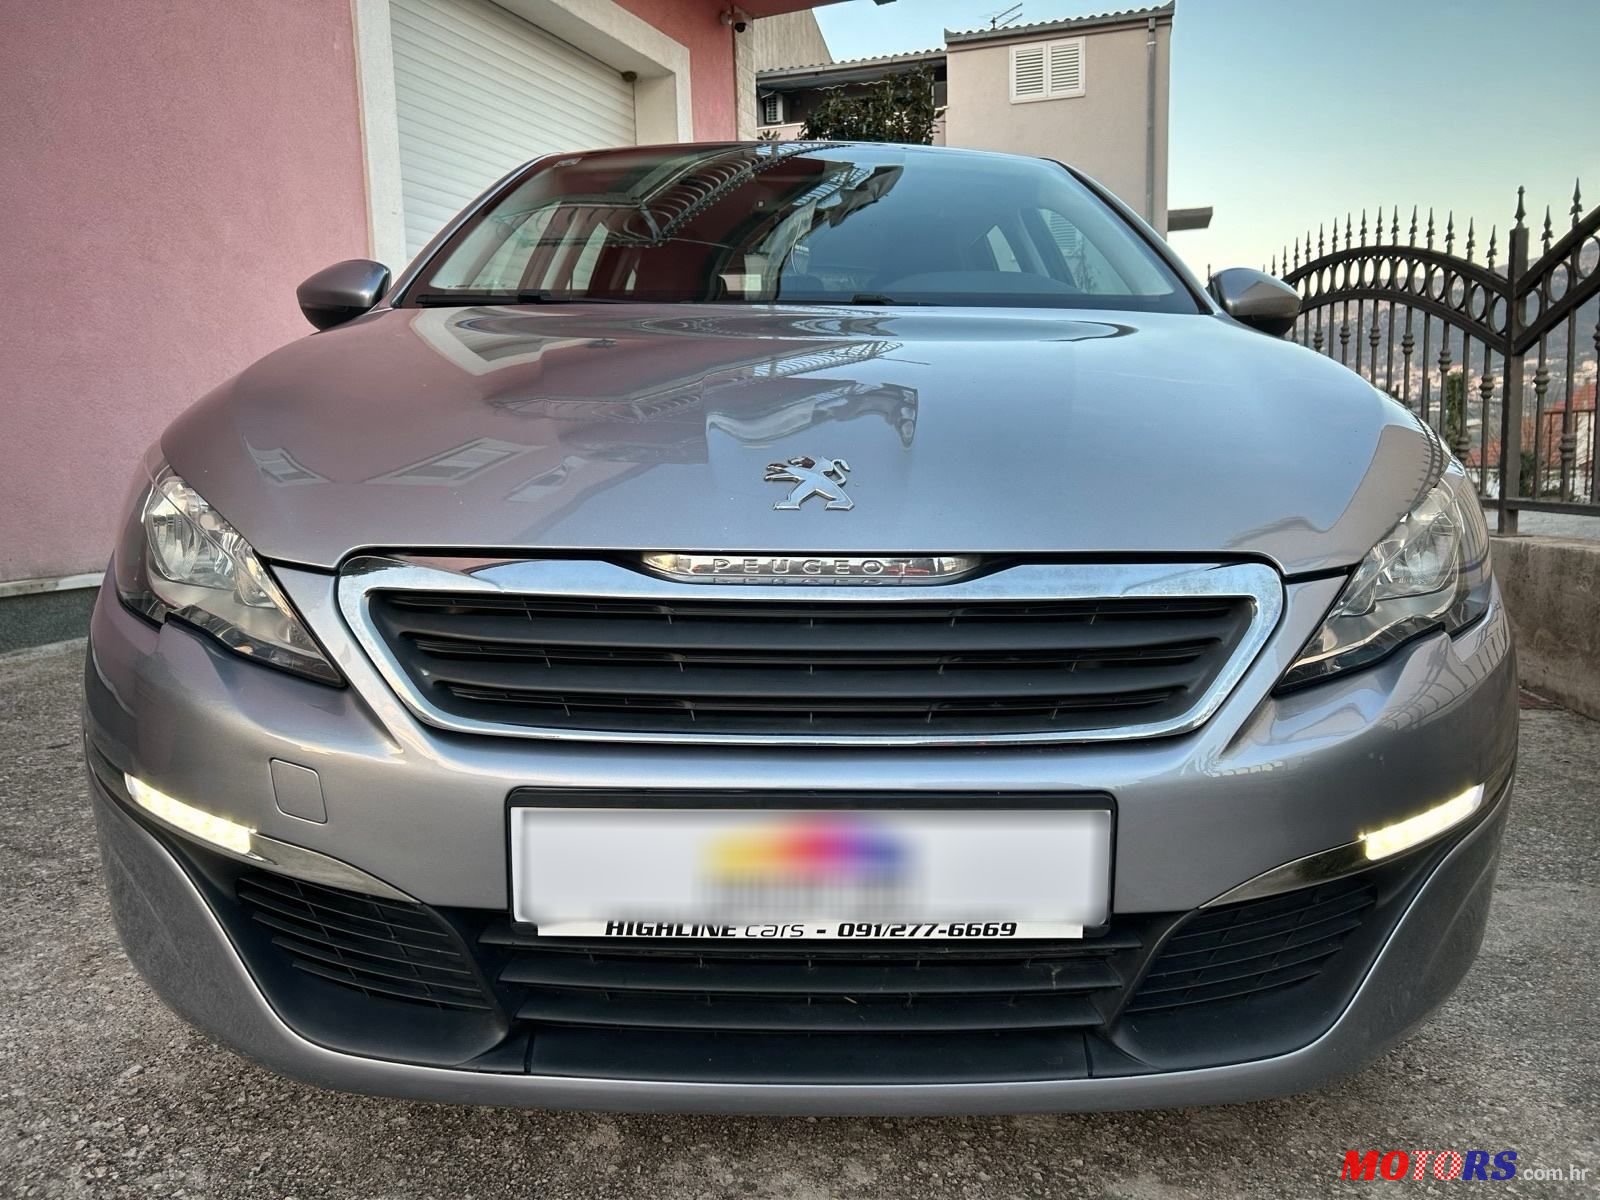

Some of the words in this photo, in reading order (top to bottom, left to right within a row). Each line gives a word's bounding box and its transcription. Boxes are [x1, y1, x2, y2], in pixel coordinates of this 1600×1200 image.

[713, 558, 911, 575] PEUGEOT
[605, 920, 737, 937] HIGHLINE
[745, 924, 805, 938] cars
[837, 922, 1018, 937] 091/277-6669
